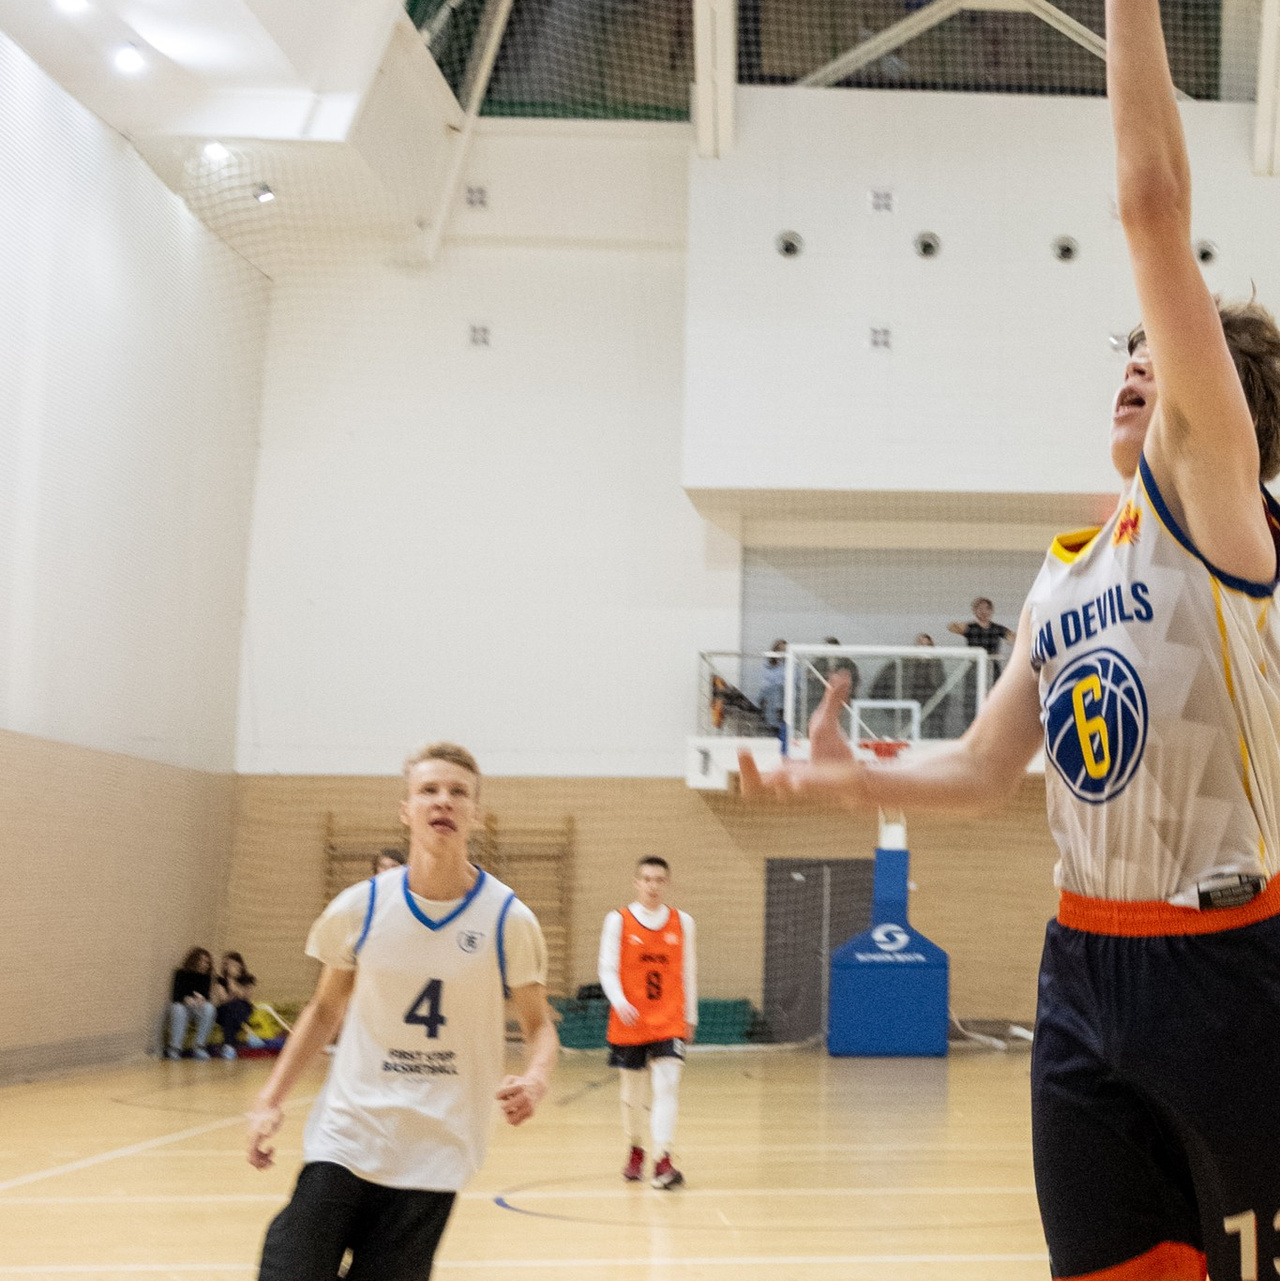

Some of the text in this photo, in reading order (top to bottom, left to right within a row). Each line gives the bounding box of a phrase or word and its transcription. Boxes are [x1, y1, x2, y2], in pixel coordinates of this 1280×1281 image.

[1060, 581, 1154, 649] DEVILS
[1072, 673, 1111, 780] 6
[404, 978, 447, 1039] 4
